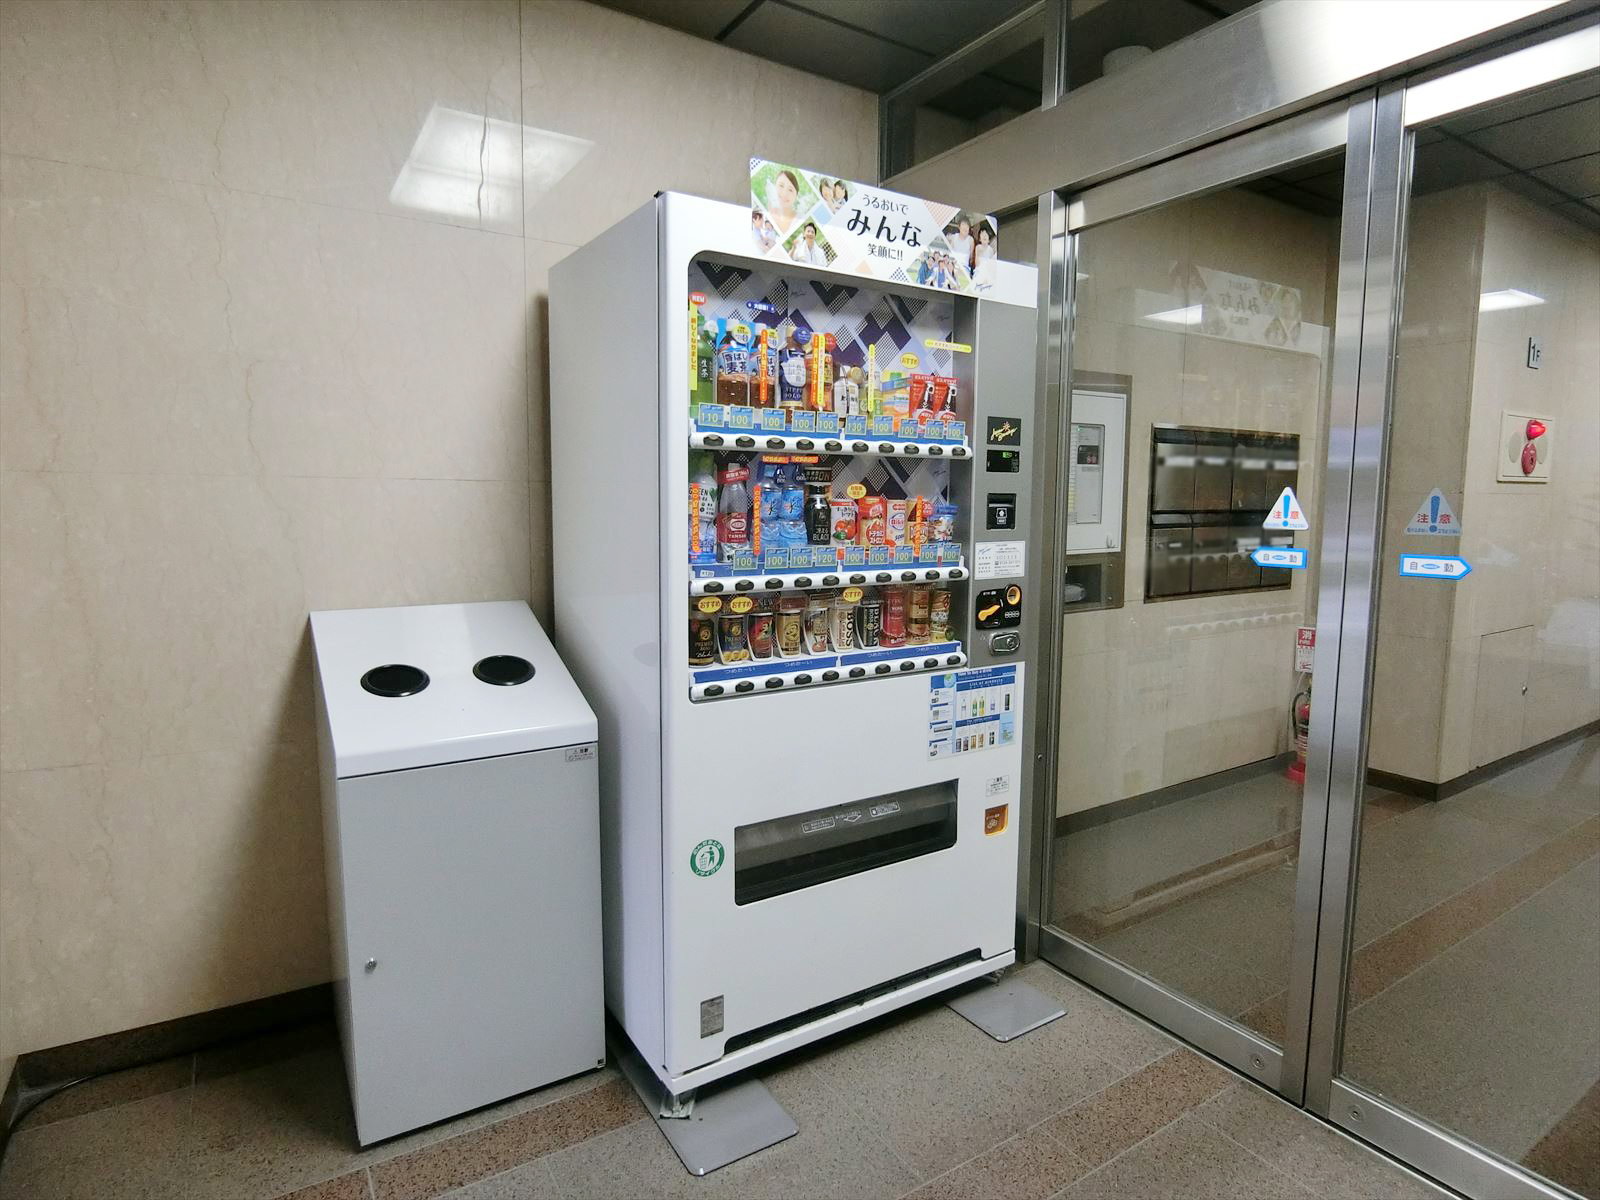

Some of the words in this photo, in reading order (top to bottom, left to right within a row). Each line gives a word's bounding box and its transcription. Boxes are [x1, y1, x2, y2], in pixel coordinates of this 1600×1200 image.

[862, 193, 909, 215] うるおいで
[847, 208, 922, 248] みんな
[867, 243, 903, 261] 笑顔に!!
[1416, 513, 1451, 524] 注意
